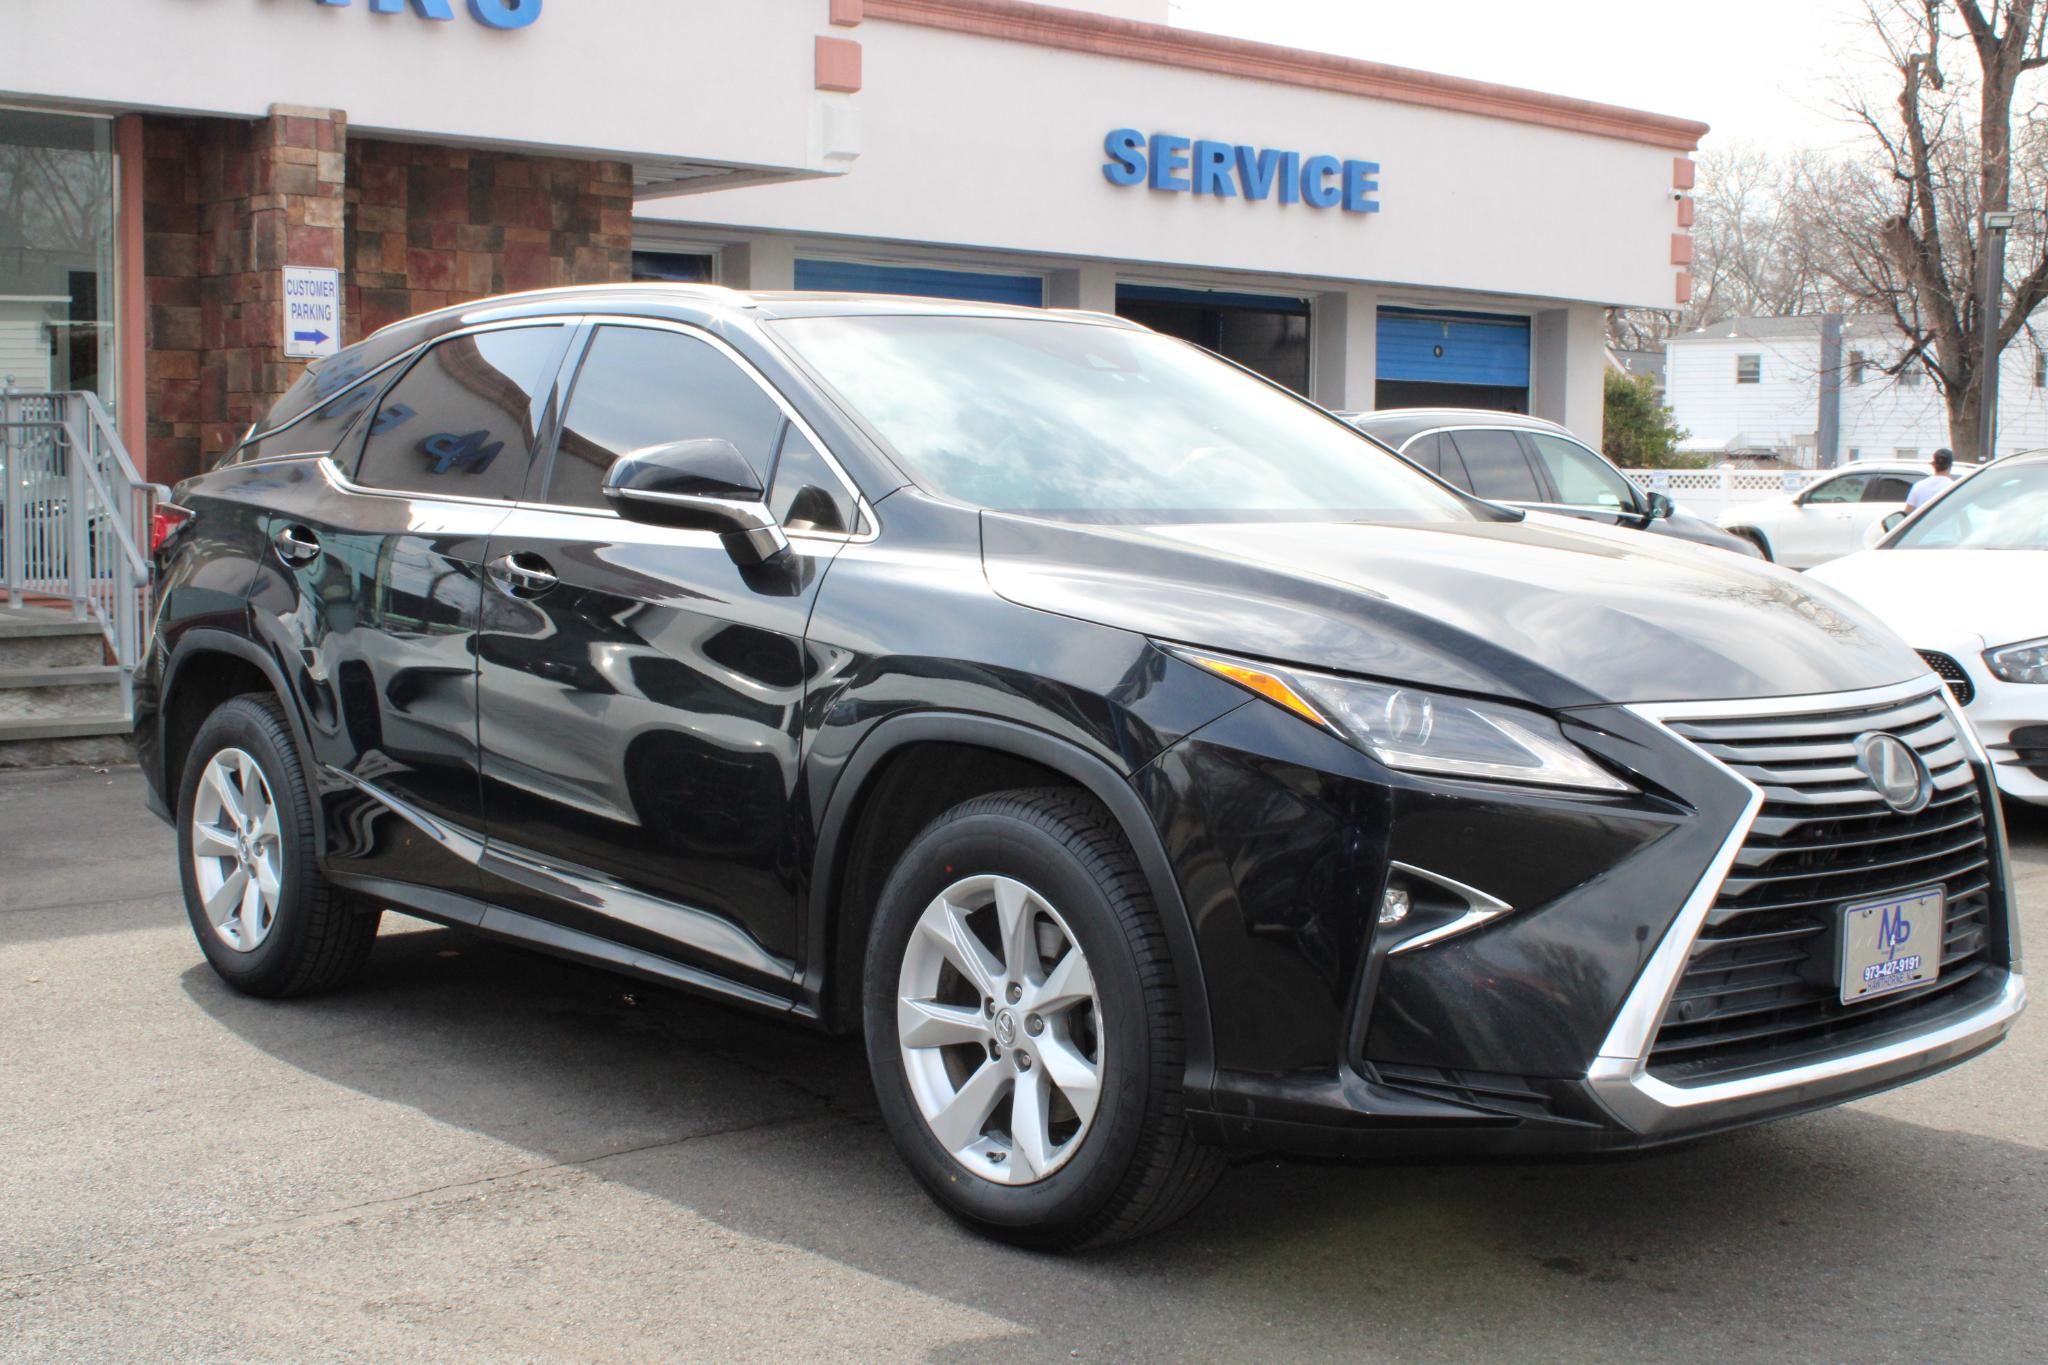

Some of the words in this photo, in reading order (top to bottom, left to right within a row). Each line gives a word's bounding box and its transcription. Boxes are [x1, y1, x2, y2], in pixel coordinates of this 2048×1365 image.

[1101, 128, 1380, 213] SERVICE
[286, 279, 335, 297] CUSTOMER
[291, 303, 332, 321] PARKING
[1864, 955, 1920, 981] 973-427-9191
